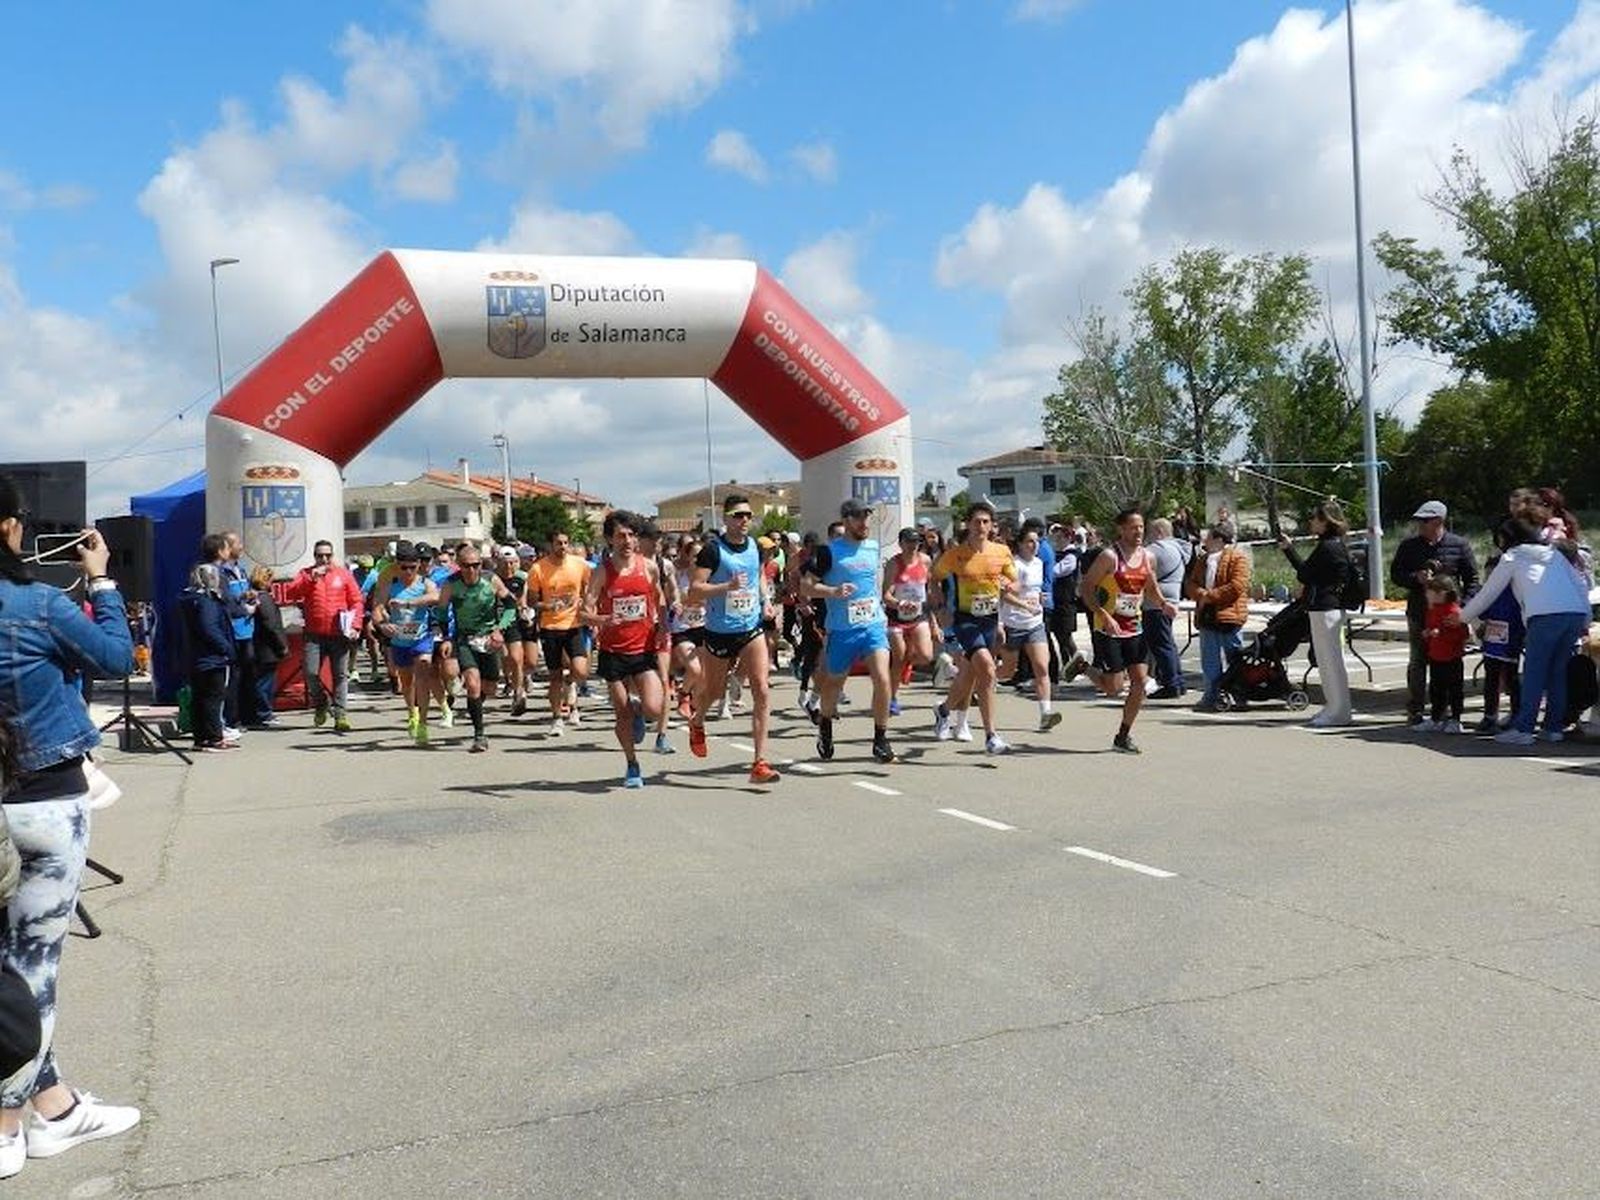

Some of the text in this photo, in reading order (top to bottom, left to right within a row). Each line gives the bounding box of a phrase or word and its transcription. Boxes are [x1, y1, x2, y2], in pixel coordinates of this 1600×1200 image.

[550, 322, 687, 343] de Salamanca
[551, 283, 665, 307] Diputación
[263, 297, 415, 430] CON EL DEPORTE
[754, 332, 860, 432] DEPORTISTAS
[763, 310, 880, 421] CON NUESTROS
